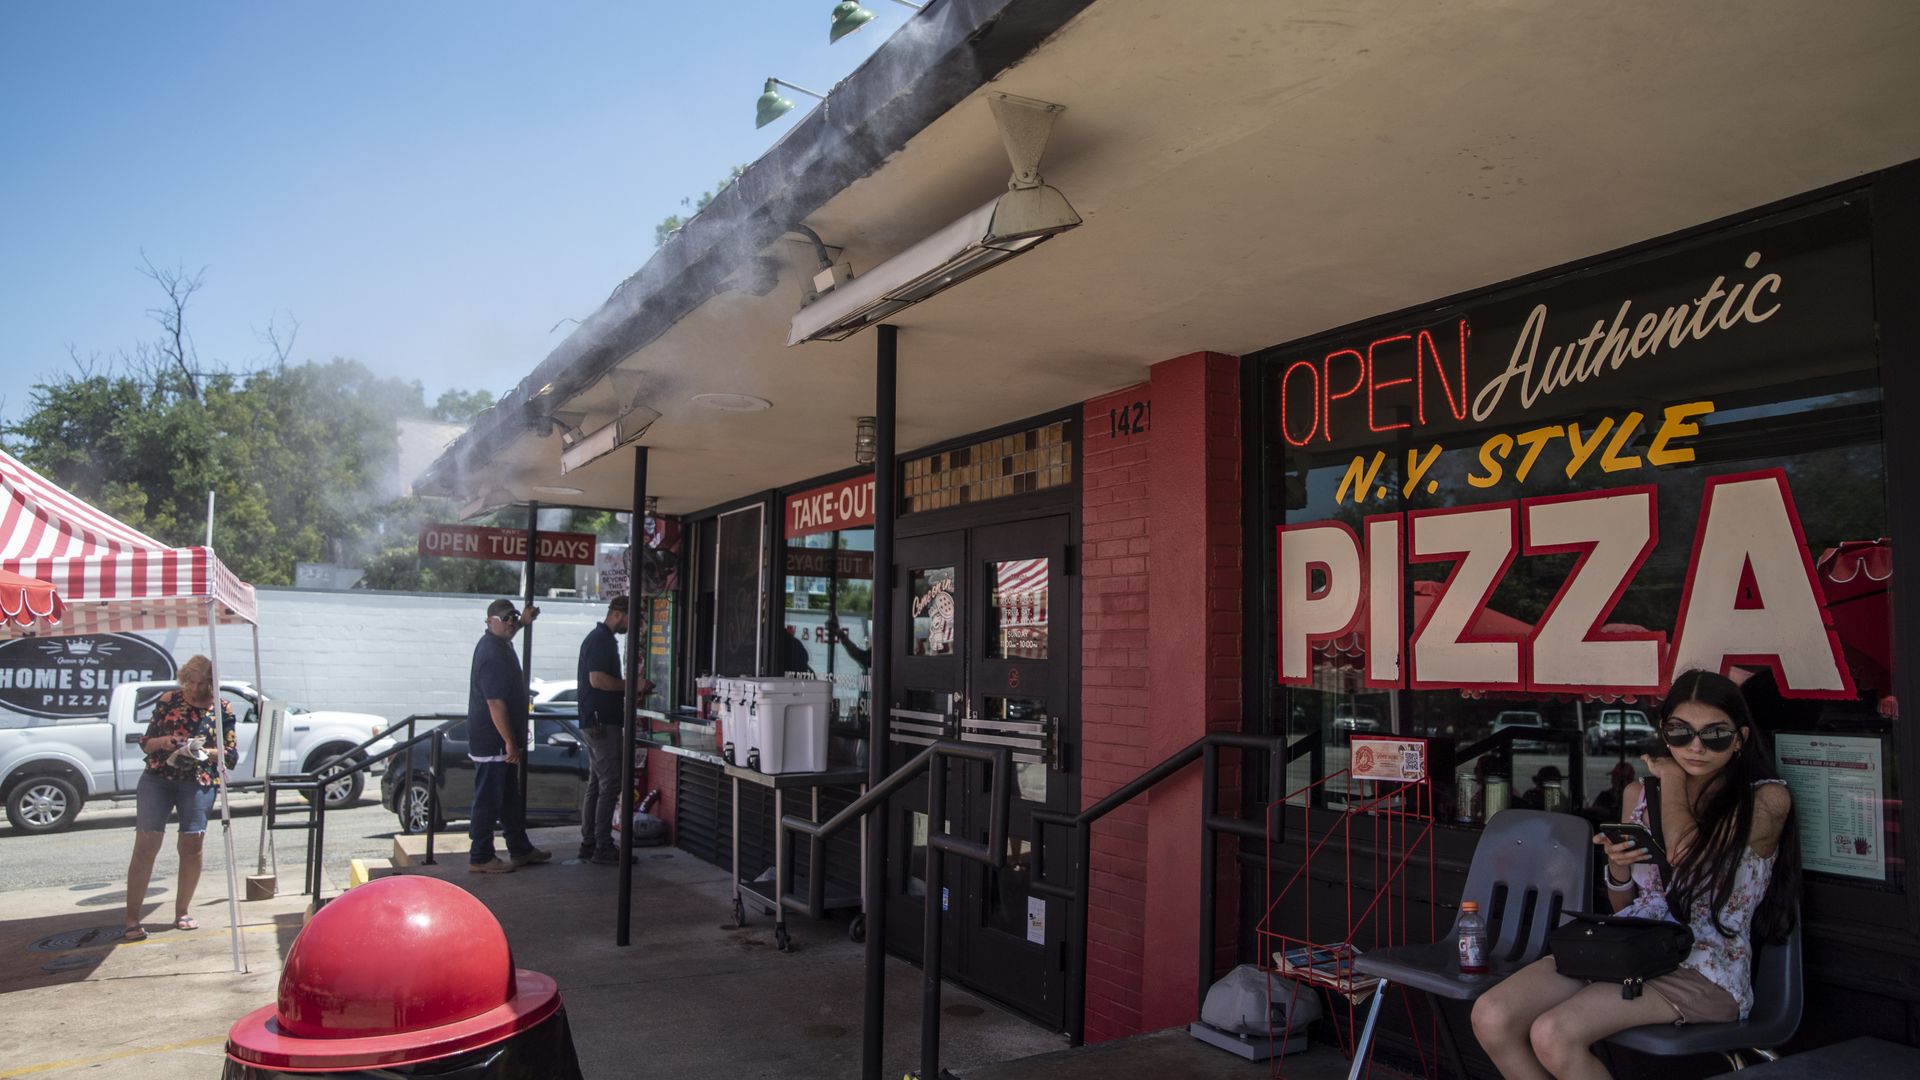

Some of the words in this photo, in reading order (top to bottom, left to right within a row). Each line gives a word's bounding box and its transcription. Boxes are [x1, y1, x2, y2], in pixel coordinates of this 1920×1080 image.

[1472, 251, 1783, 422] Authentic
[1281, 318, 1471, 446] OPEN
[1110, 399, 1152, 439] 1421
[1335, 443, 1444, 505] N.Y.
[1467, 400, 1715, 488] STYLE
[792, 482, 876, 530] TAKE-OUT
[425, 531, 479, 553] OPEN
[609, 582, 623, 590] THIS
[1277, 466, 1859, 700] PIZZA
[1007, 630, 1028, 638] SUNDAY
[0, 668, 73, 689] HOME
[80, 669, 153, 689] SLICE
[42, 695, 108, 706] PIZZA
